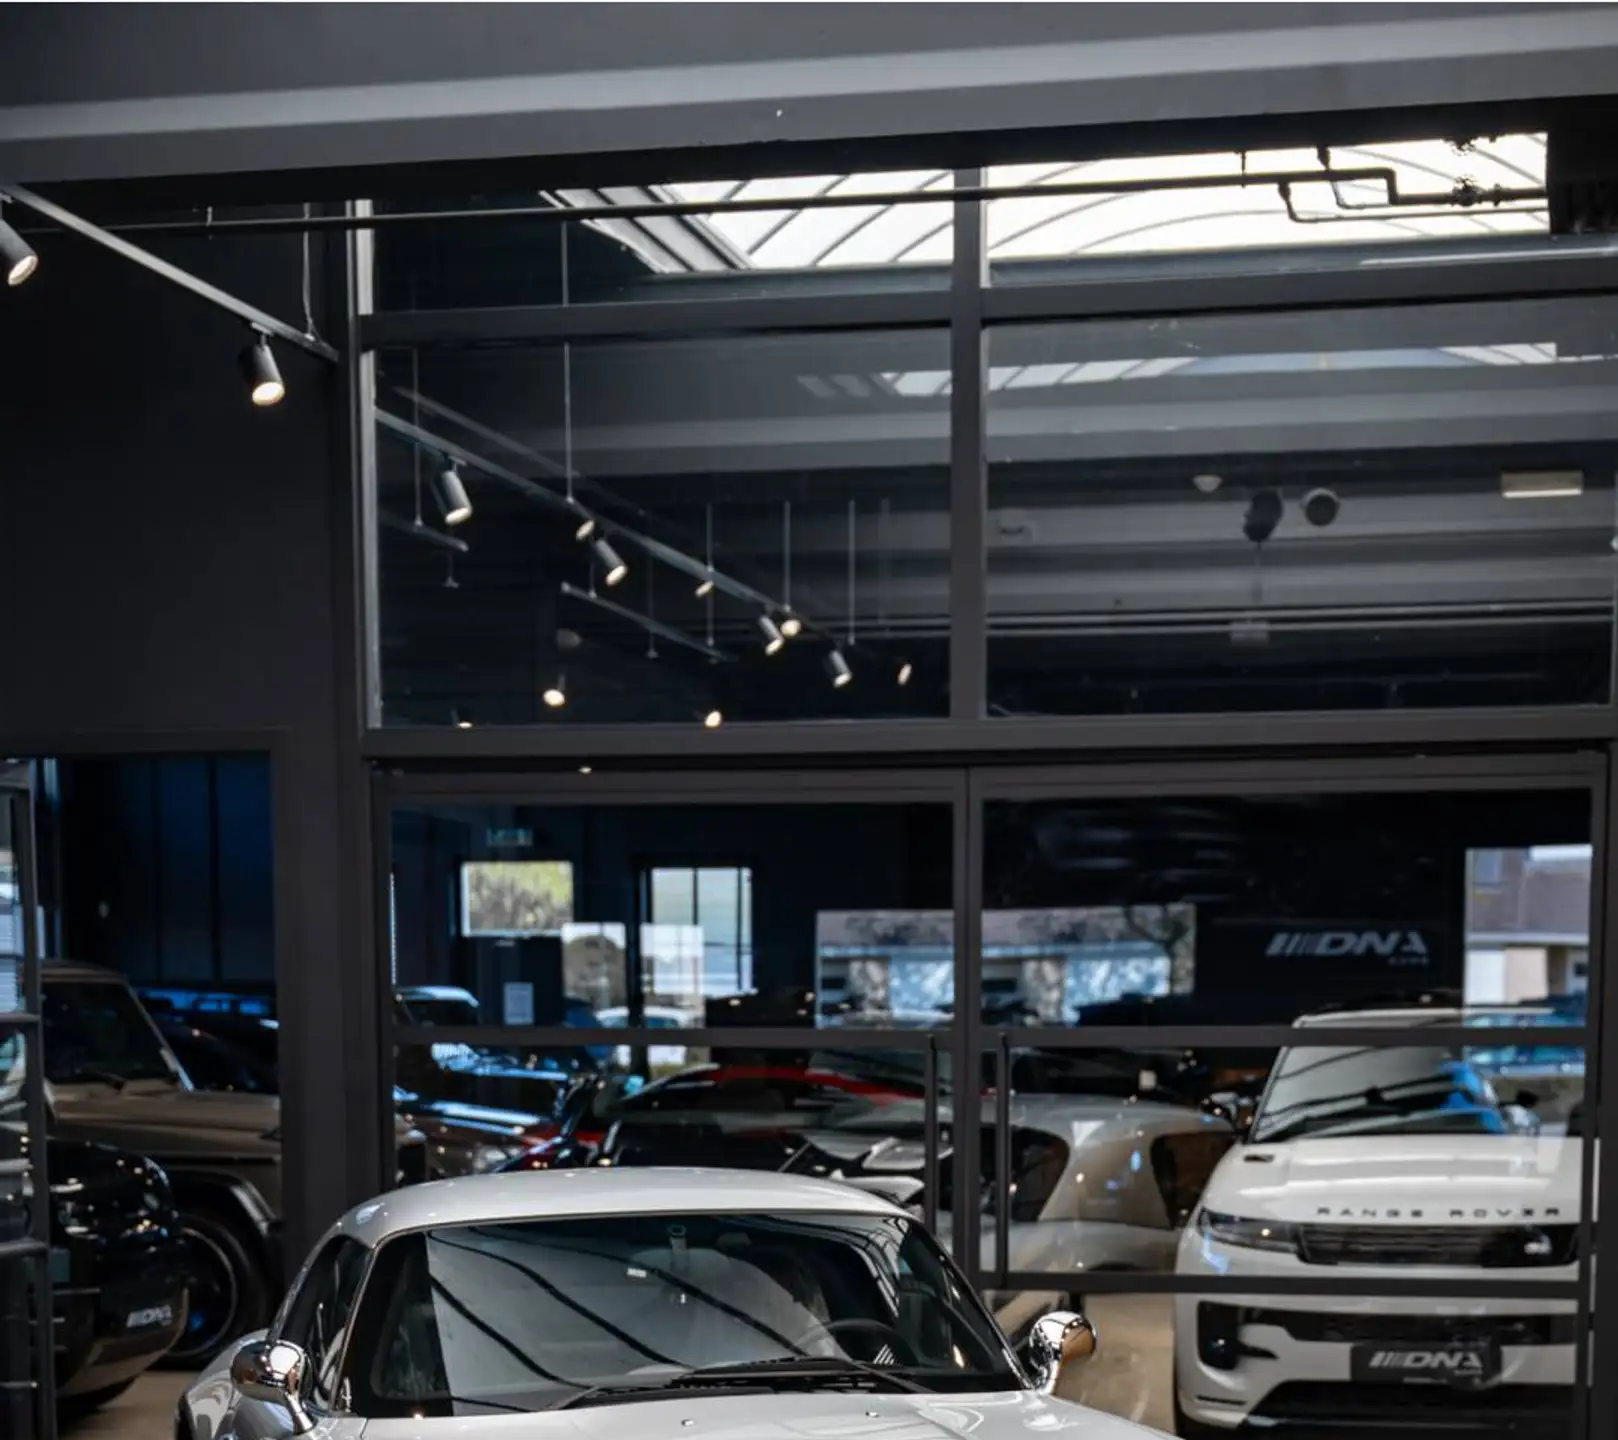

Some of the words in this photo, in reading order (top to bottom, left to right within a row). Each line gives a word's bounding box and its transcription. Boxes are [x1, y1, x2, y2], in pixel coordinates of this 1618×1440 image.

[1314, 931, 1427, 956] DNA
[1317, 1207, 1423, 1218] RANGE
[1449, 1207, 1560, 1218] ROVER
[1403, 1351, 1483, 1368] DNA
